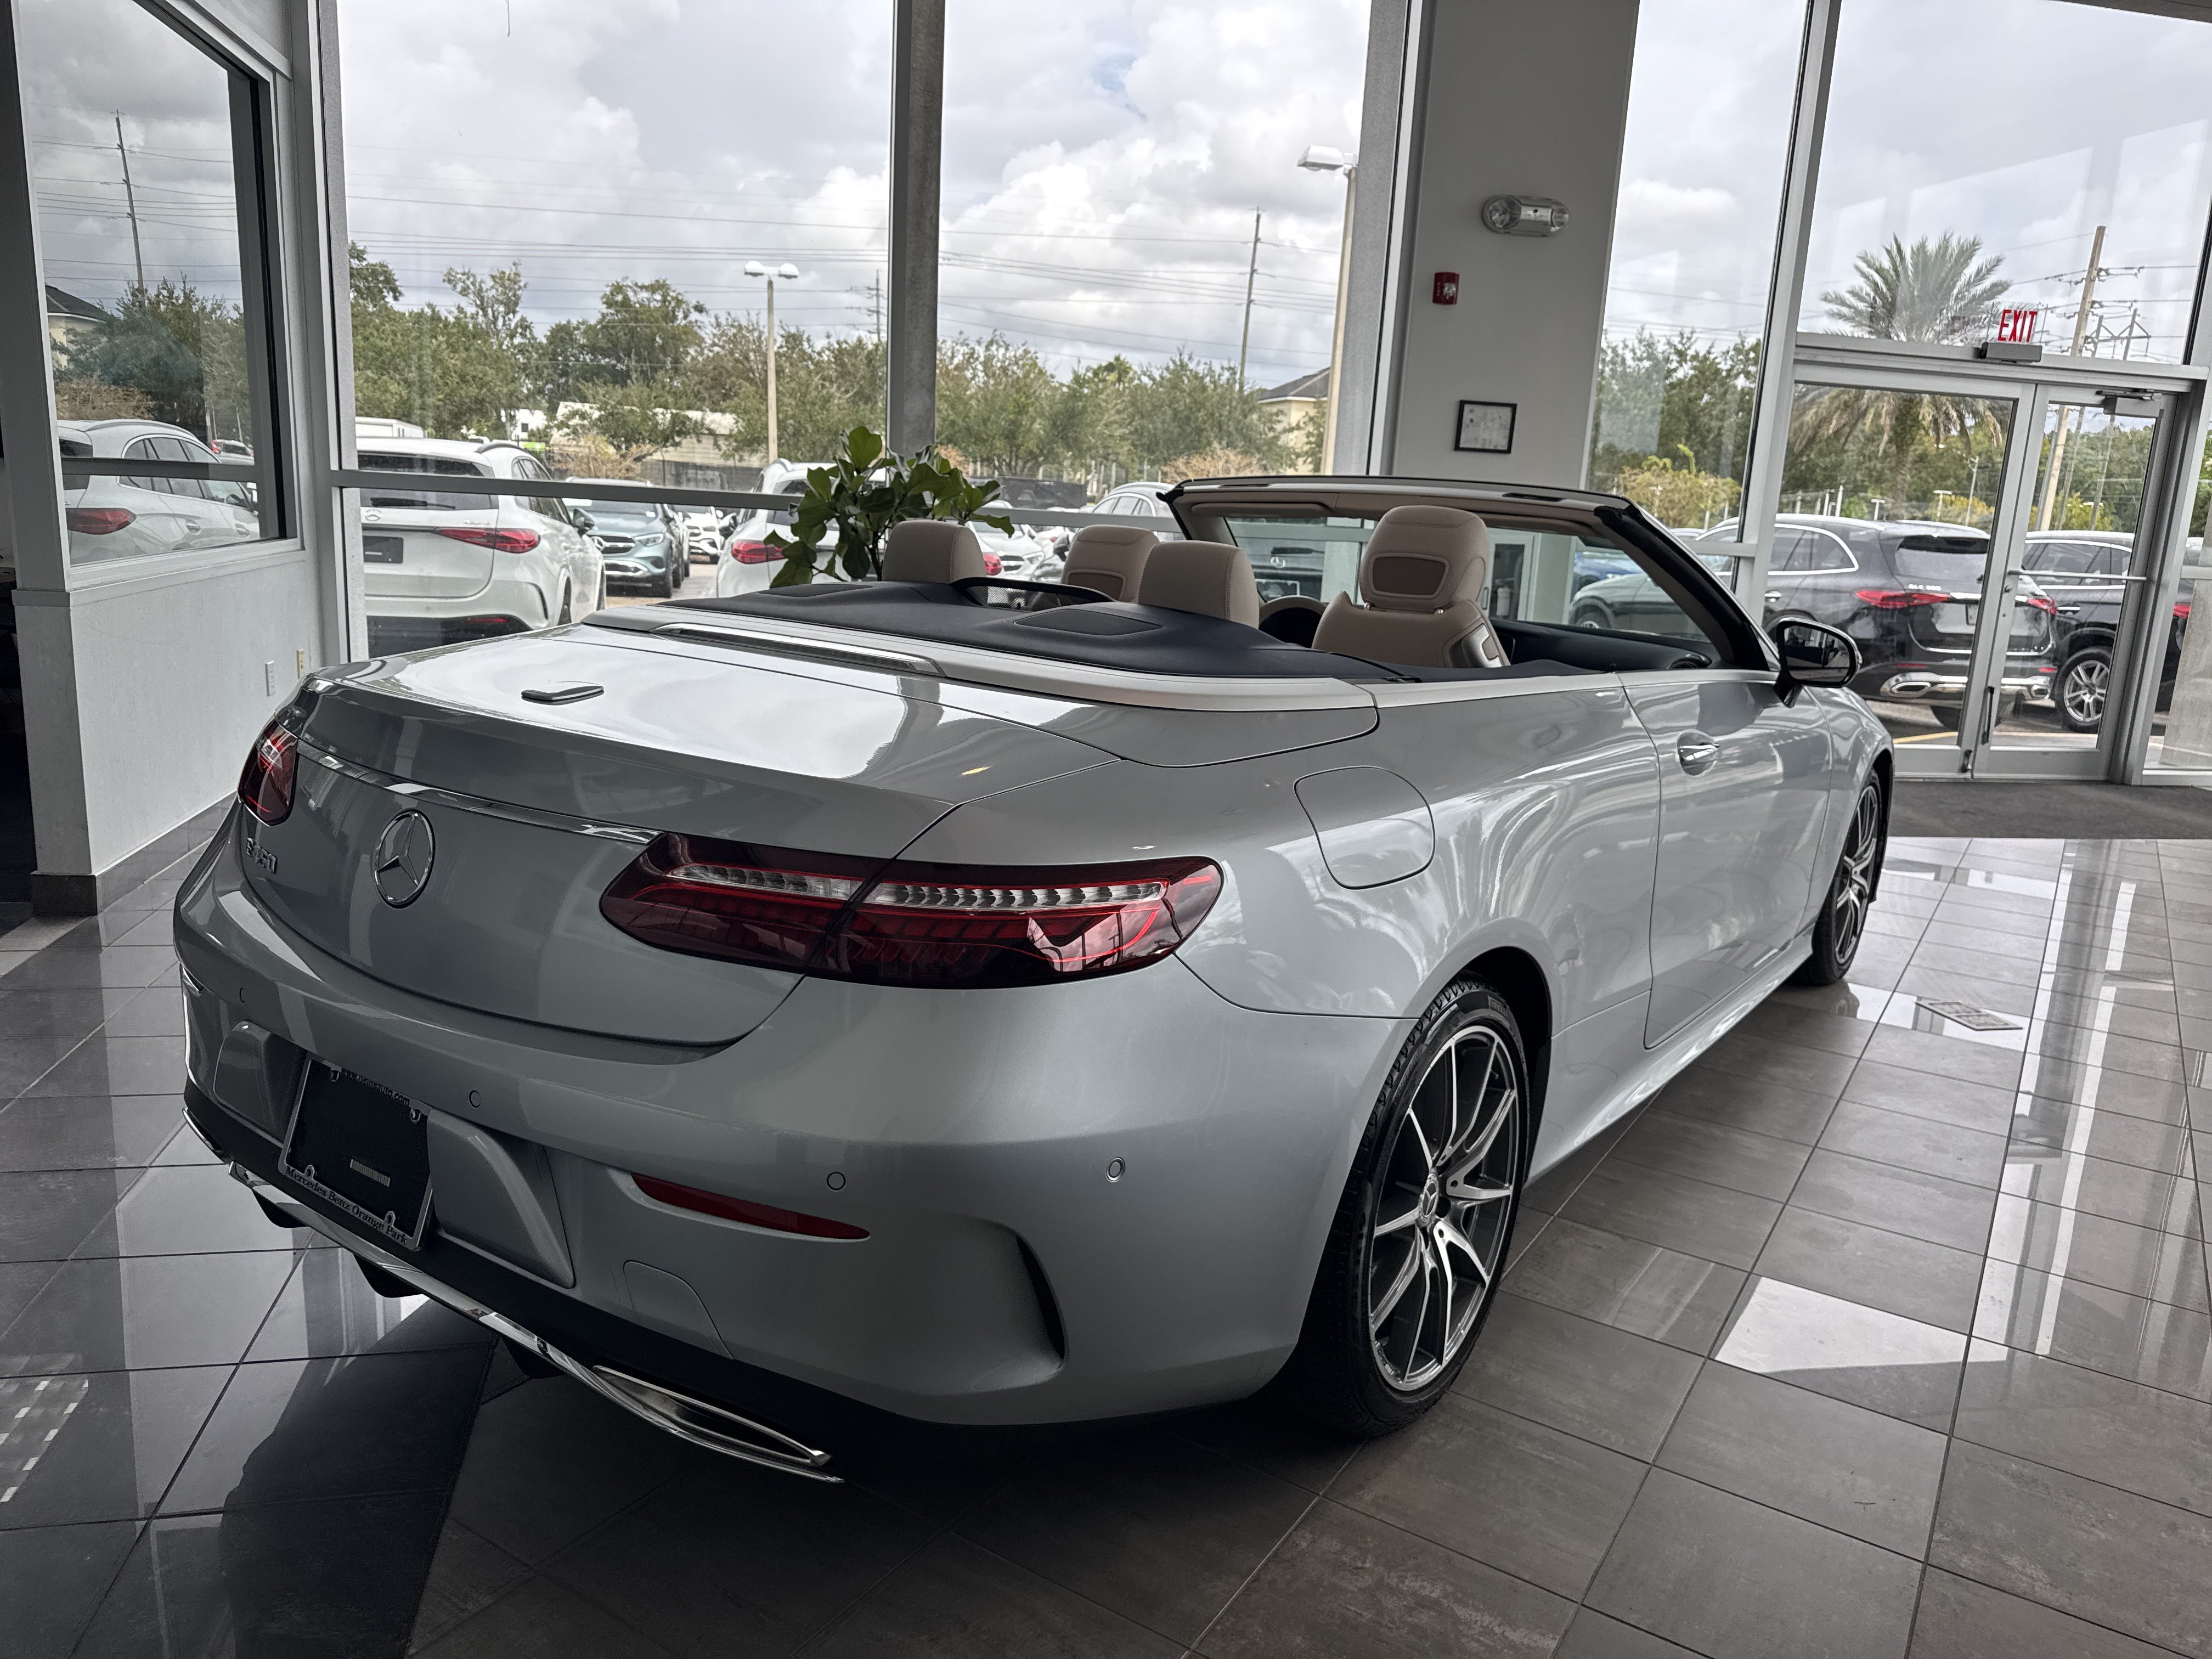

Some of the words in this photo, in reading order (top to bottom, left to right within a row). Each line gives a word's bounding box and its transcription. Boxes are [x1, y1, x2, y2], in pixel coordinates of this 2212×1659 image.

[1997, 309, 2038, 342] EXIT
[352, 1205, 385, 1231] Orange
[386, 1224, 407, 1245] Park
